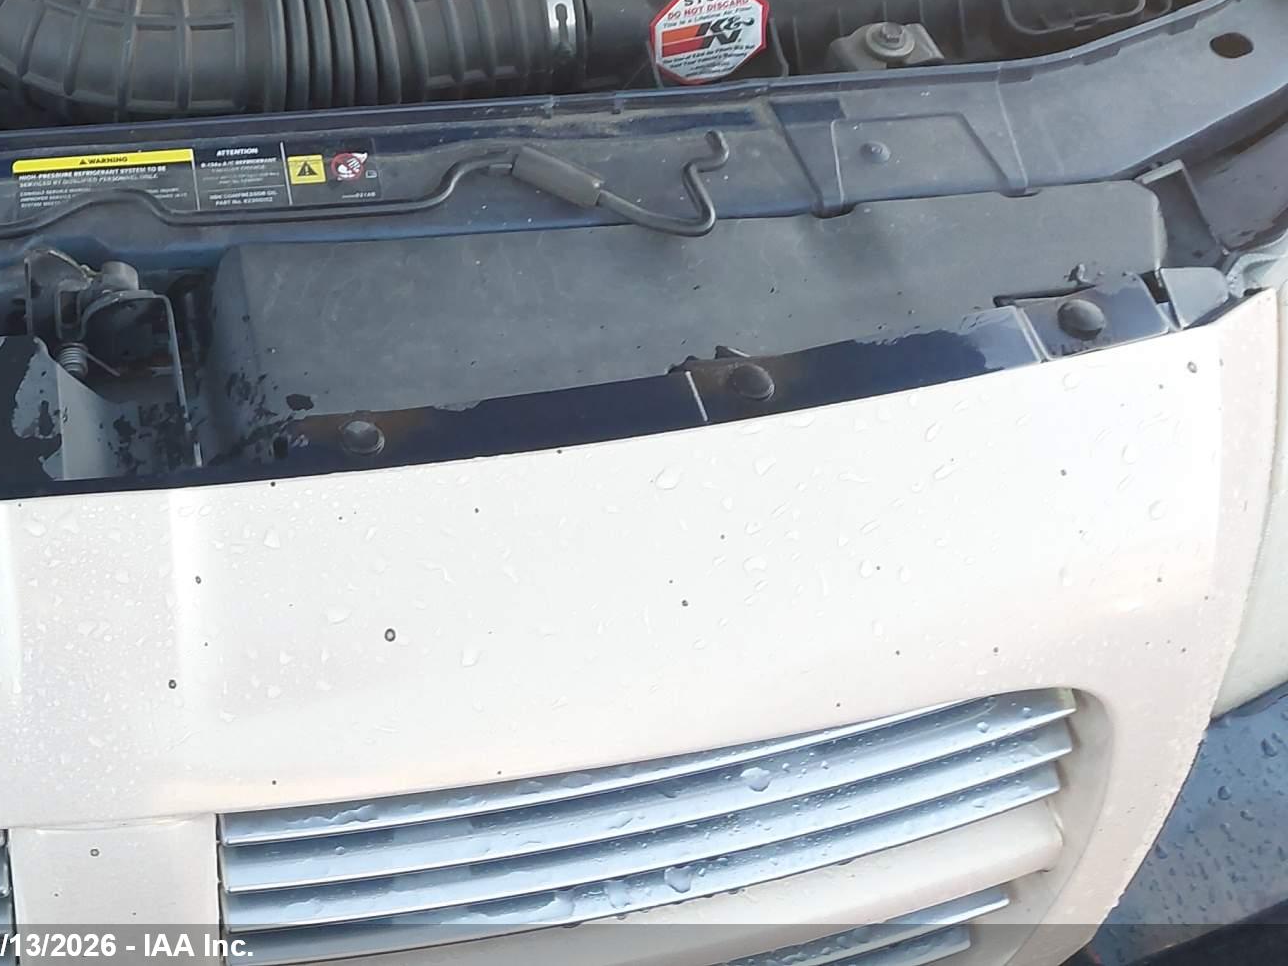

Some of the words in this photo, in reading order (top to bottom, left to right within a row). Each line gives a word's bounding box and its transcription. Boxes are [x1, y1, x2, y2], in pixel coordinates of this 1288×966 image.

[667, 10, 681, 20] DO
[684, 5, 705, 18] NOT
[216, 147, 259, 157] ATTENTION
[88, 156, 128, 165] WARNING
[19, 171, 72, 181] HIGH-PRESSURE
[74, 168, 119, 177] REFRIGERANT
